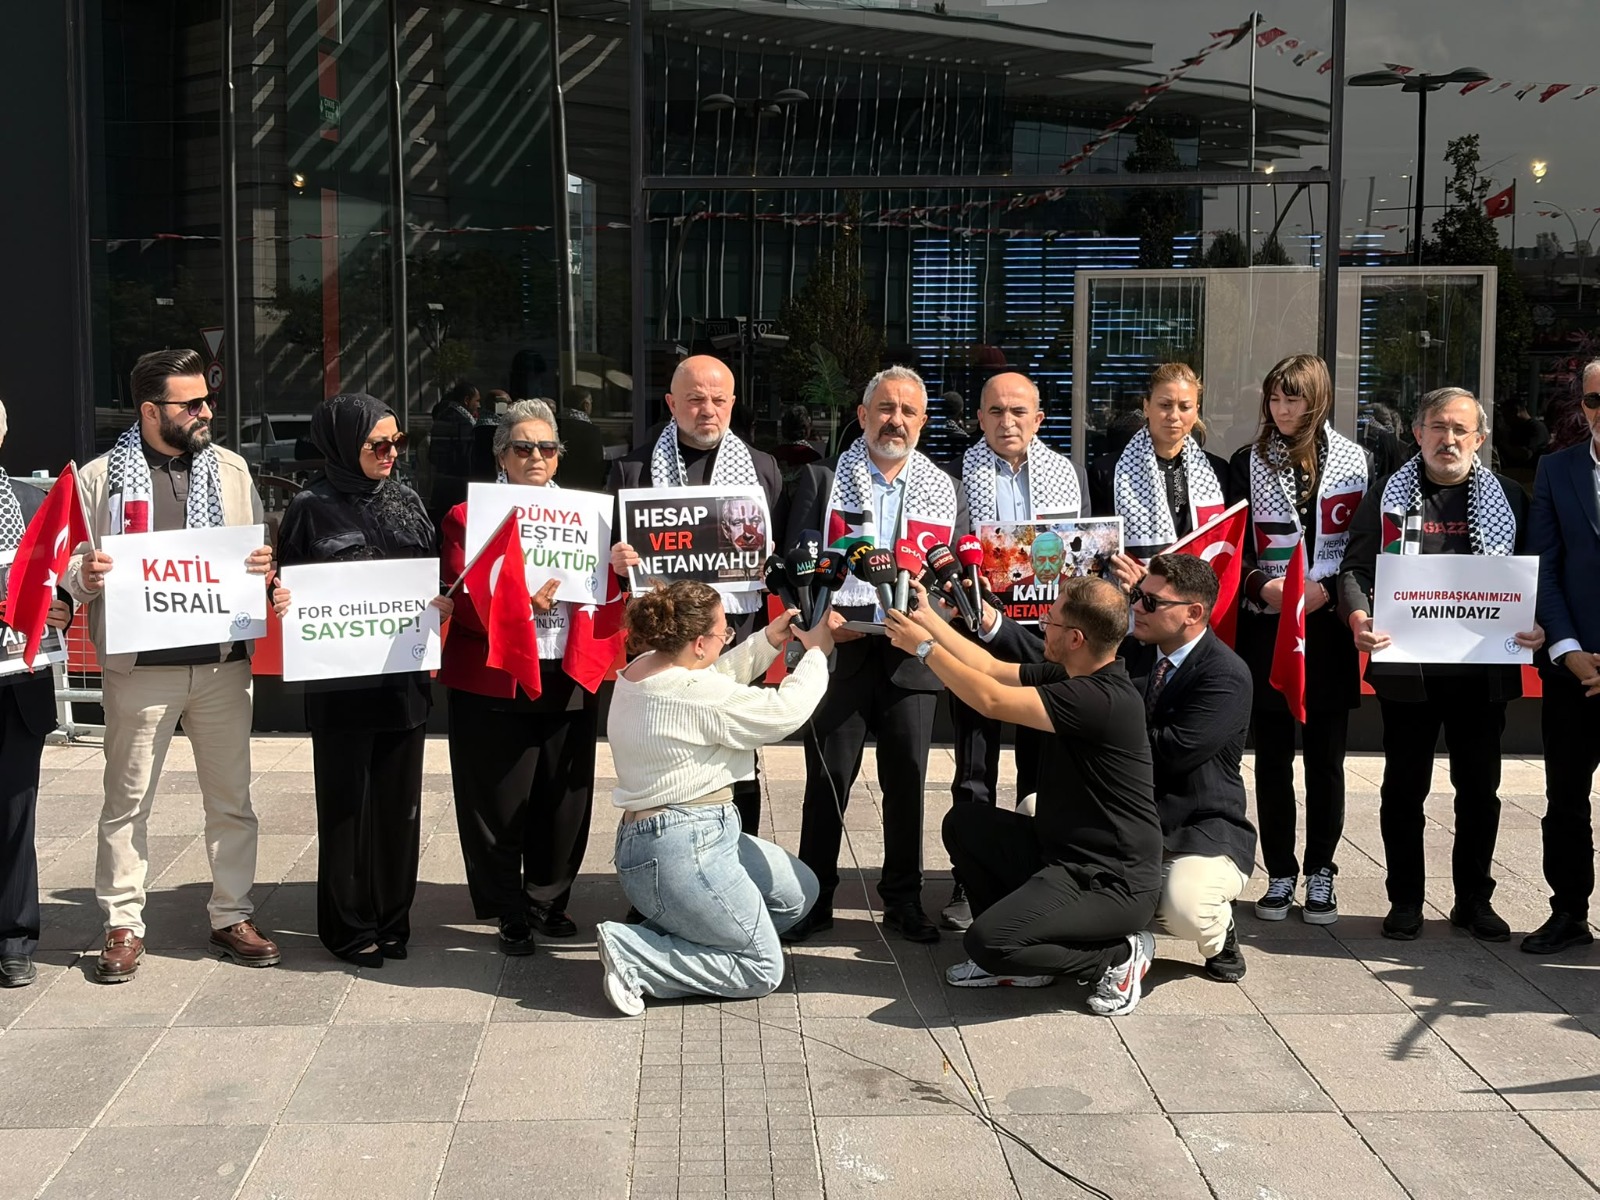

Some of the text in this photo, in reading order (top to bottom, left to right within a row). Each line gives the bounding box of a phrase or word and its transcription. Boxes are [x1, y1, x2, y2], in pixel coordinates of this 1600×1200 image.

[515, 504, 583, 526] DÜNYA
[634, 506, 708, 528] HESAP
[520, 524, 588, 545] EŞTEN
[1423, 521, 1469, 534] GAZZ
[649, 531, 693, 551] VER
[960, 542, 981, 552] akit
[1323, 537, 1350, 549] HEPİM
[522, 544, 598, 573] YÜKTÜR
[849, 545, 874, 565] NTV
[869, 553, 891, 565] CNN
[901, 545, 922, 560] DHA
[142, 555, 220, 583] KATİL
[638, 551, 760, 575] NETANYAHU
[1261, 564, 1288, 574] HEPİM
[145, 586, 230, 614] İSRAİL
[1394, 591, 1522, 603] CUMHURBAŞKANIMIZIN
[298, 599, 426, 619] FOR CHİLDREN
[1003, 603, 1053, 618] NETAN
[1411, 606, 1501, 620] YANINDAYIZ
[301, 616, 421, 641] SAYSTOP!
[535, 616, 565, 629] İNLİYİZ
